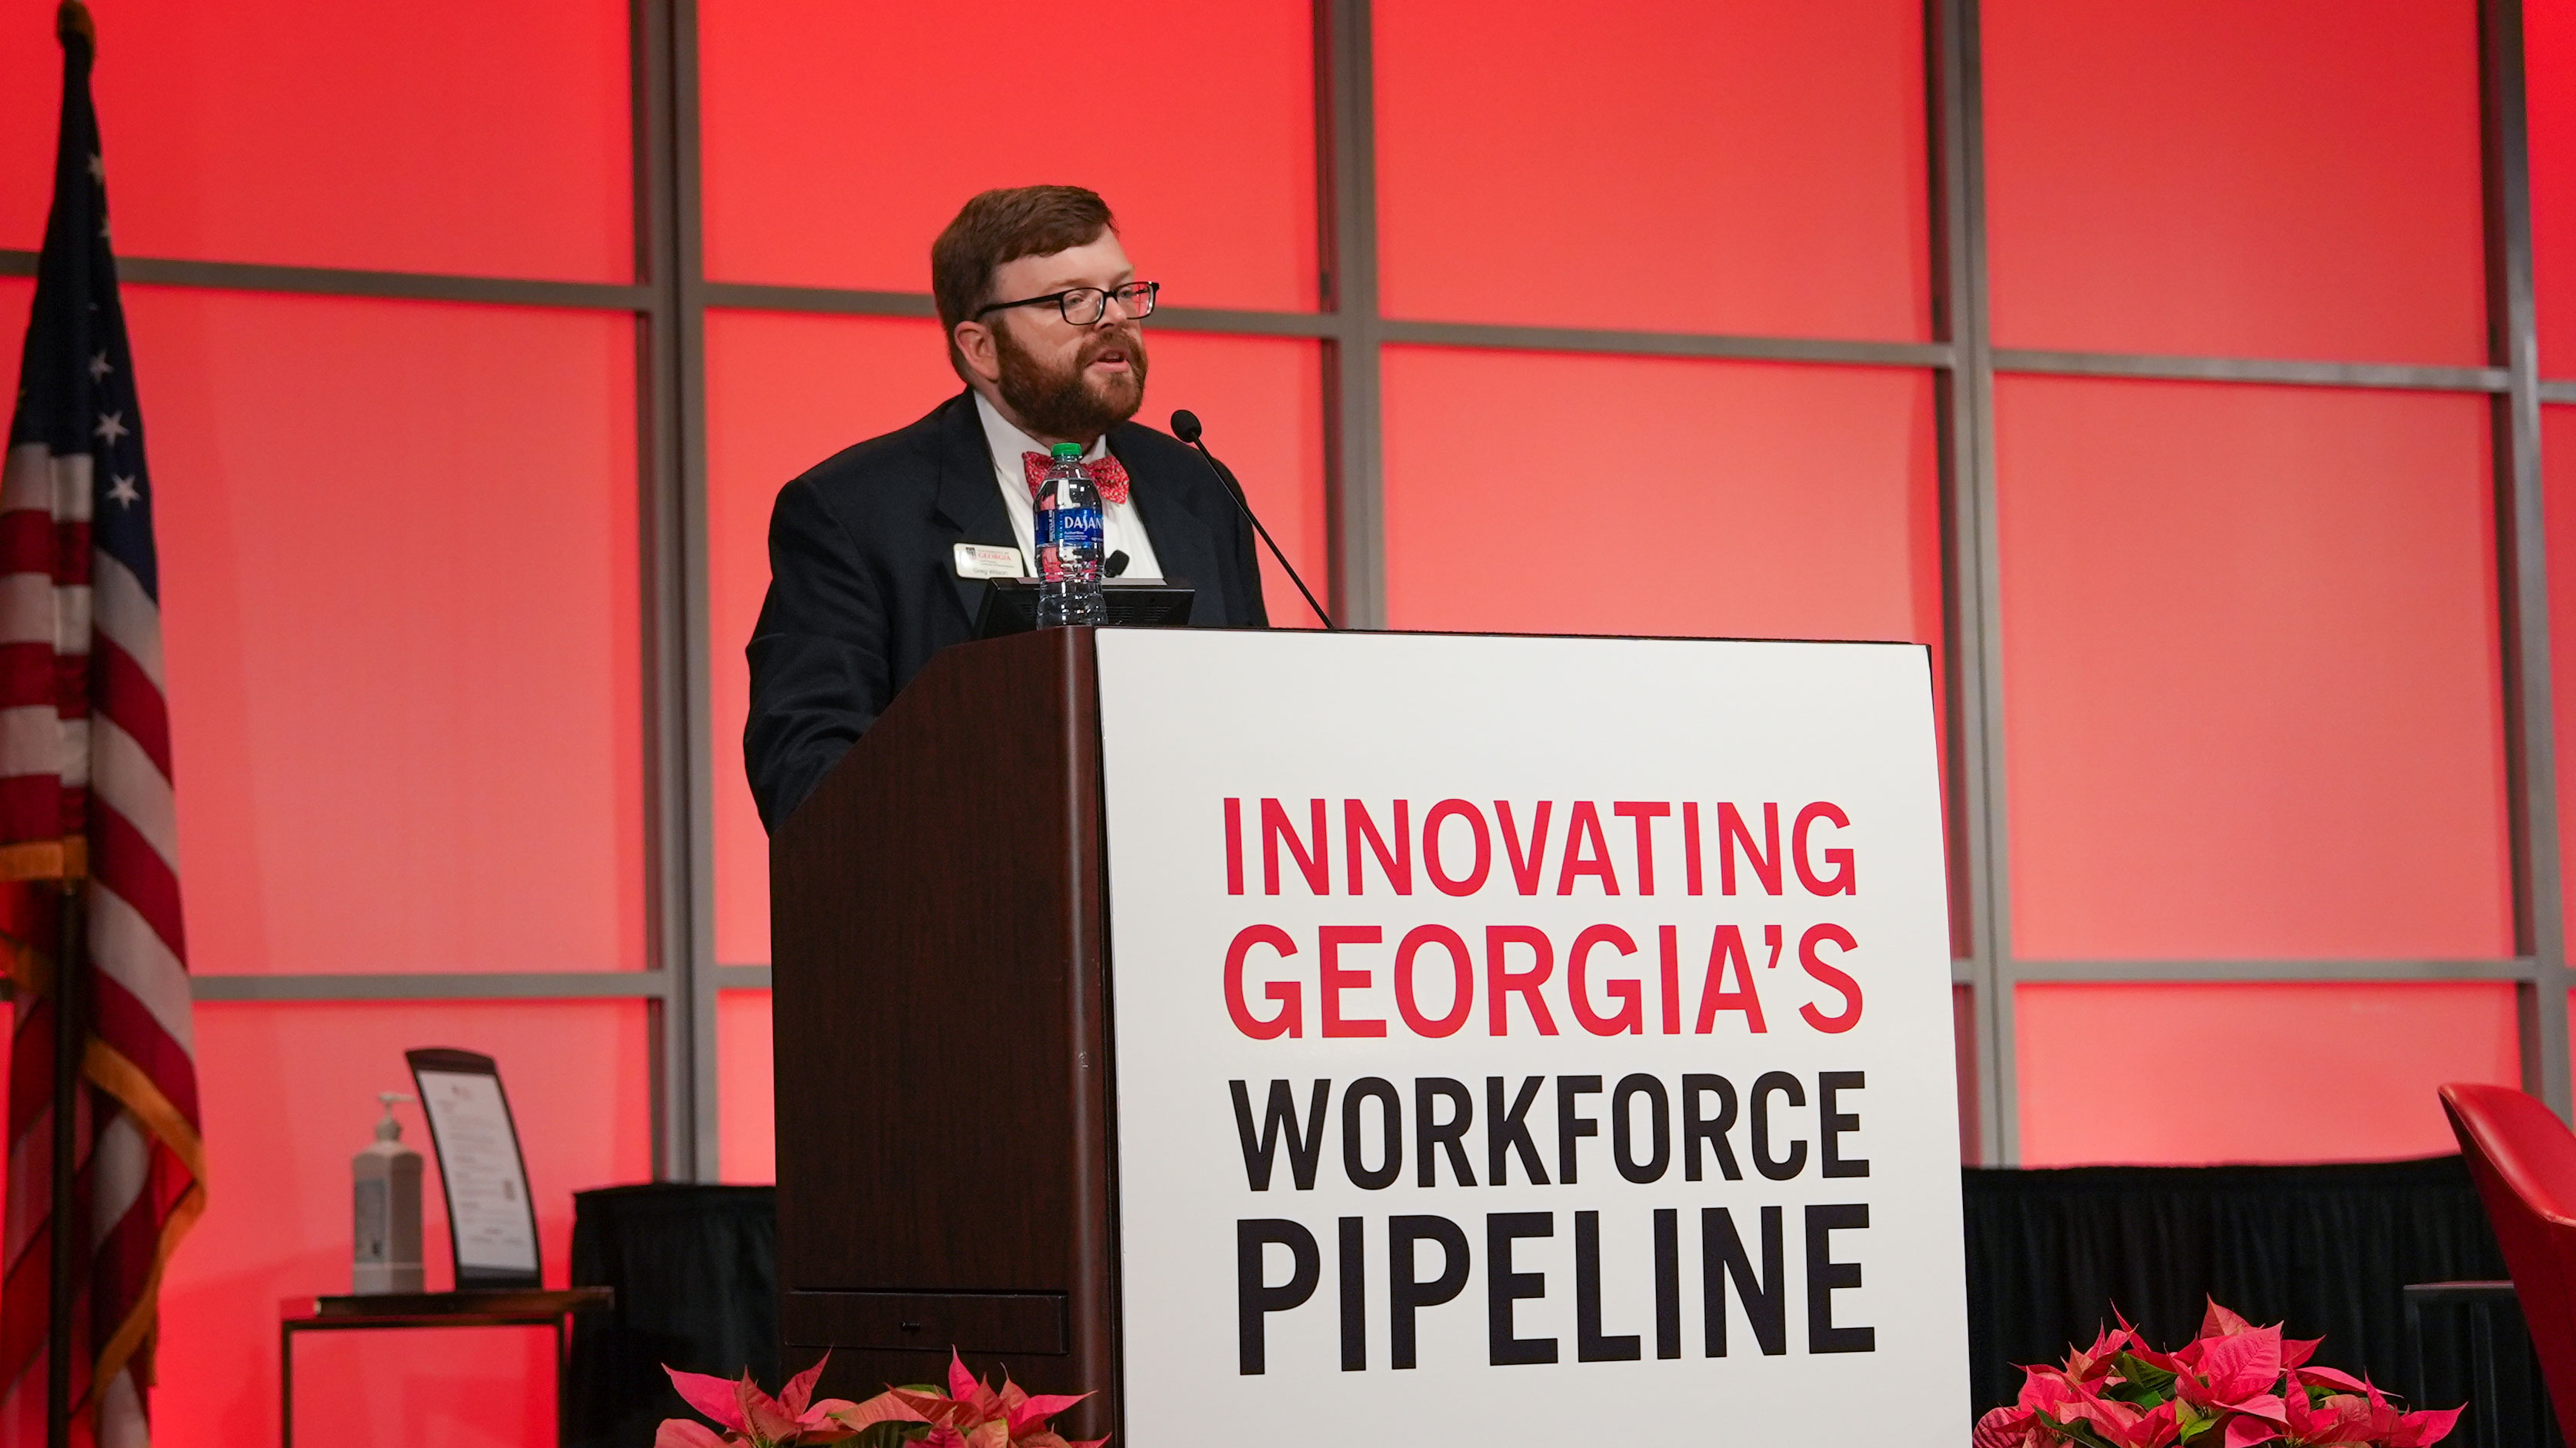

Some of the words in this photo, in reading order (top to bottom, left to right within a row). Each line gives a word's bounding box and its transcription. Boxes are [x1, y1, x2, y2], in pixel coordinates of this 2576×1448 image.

[978, 552, 1011, 561] GEORGIA
[1223, 797, 1856, 897] INNOVATING
[1223, 923, 1863, 1040] GEORGIA'S
[1228, 1070, 1870, 1192] WORKFORCE
[1237, 1203, 1876, 1376] PIPELINE
